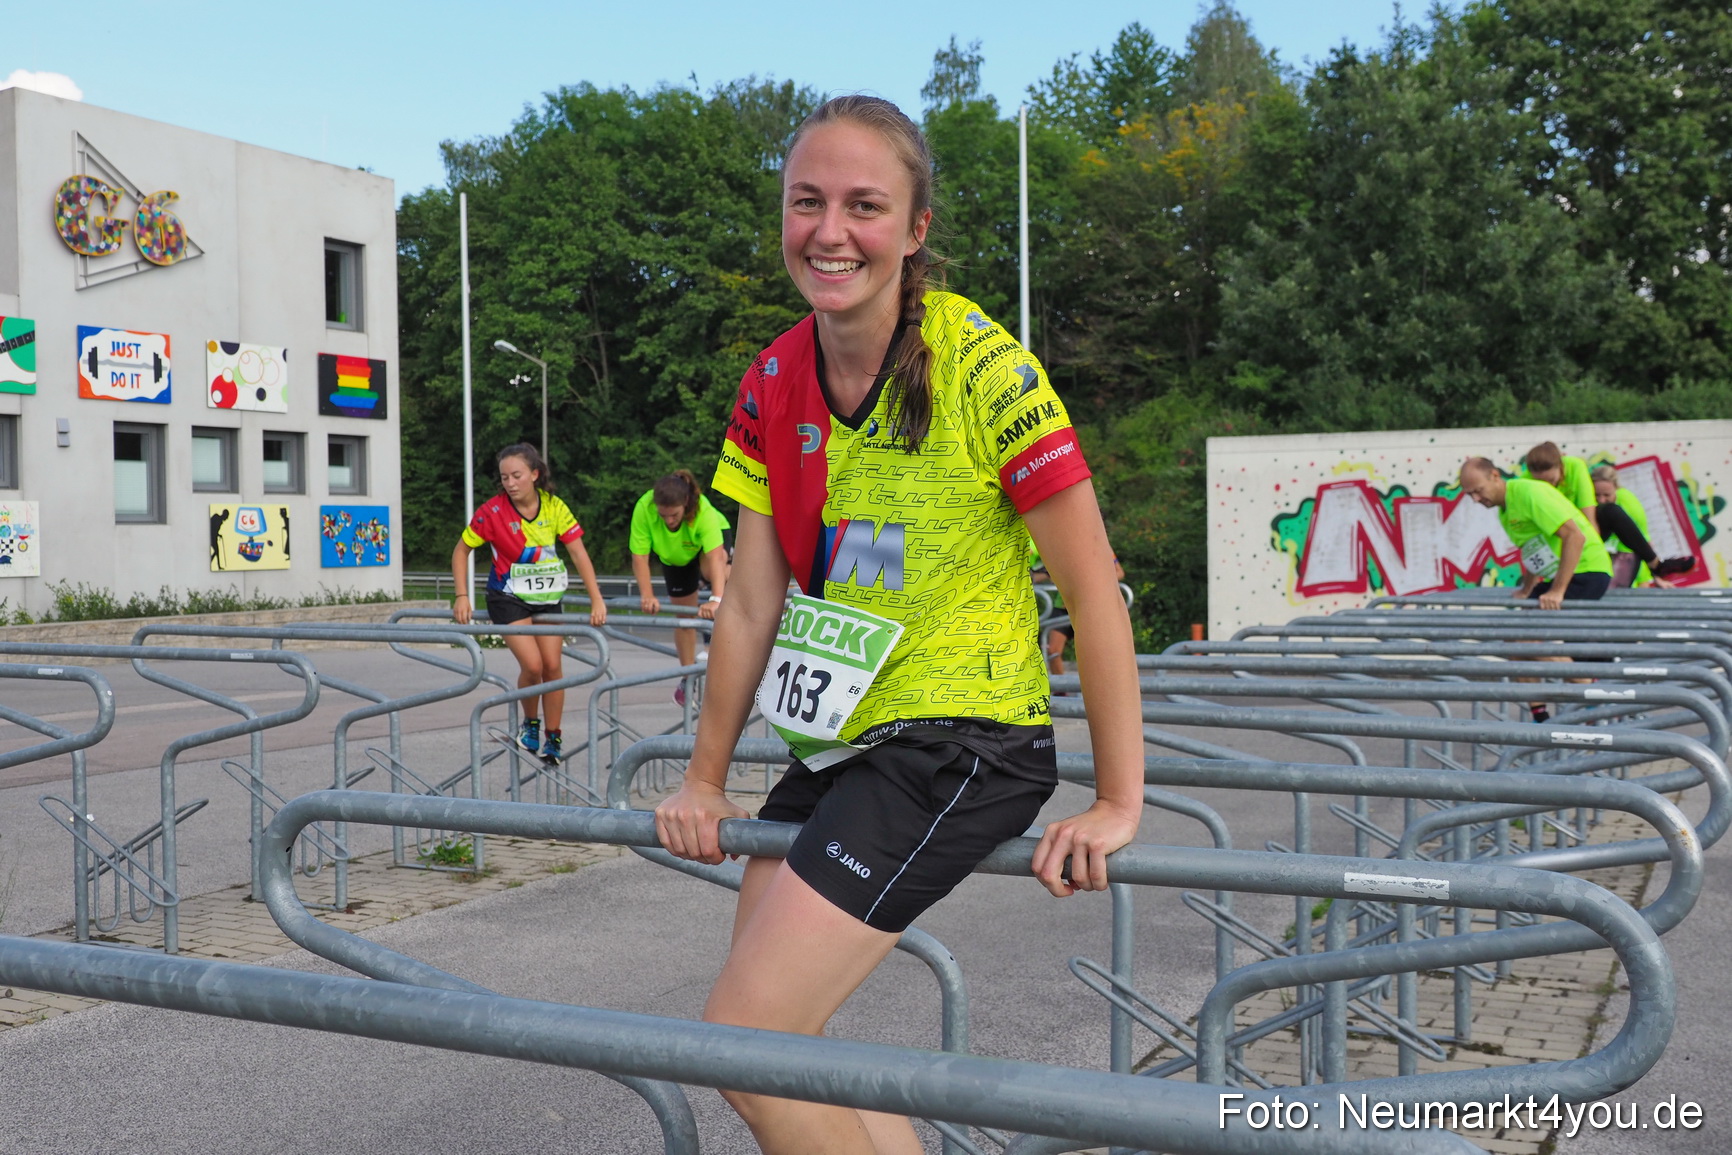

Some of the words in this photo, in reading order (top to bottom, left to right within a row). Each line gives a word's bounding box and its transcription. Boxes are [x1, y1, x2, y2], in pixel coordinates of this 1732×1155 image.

[110, 341, 141, 359] JUST
[111, 371, 126, 388] DO
[130, 373, 142, 389] IT
[990, 396, 1002, 412] THE
[1000, 382, 1019, 401] NEXT
[1028, 440, 1076, 473] Motorsport
[524, 577, 555, 591] 157
[775, 660, 832, 724] 163
[848, 684, 862, 696] E6
[839, 853, 871, 879] JAKO
